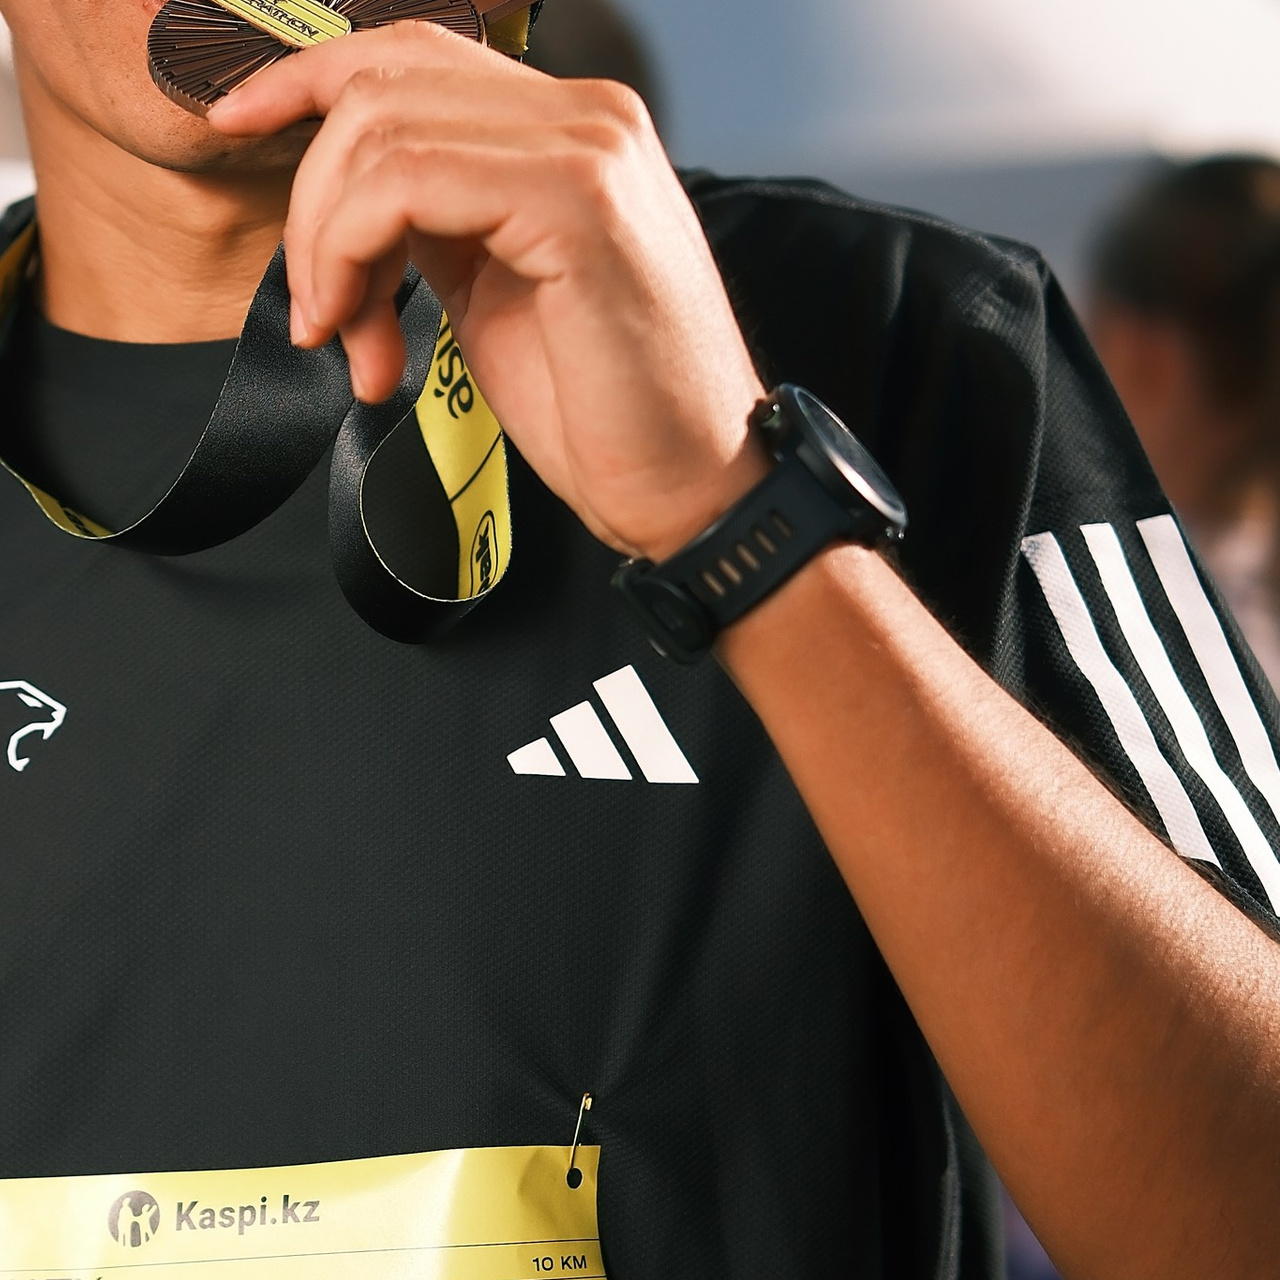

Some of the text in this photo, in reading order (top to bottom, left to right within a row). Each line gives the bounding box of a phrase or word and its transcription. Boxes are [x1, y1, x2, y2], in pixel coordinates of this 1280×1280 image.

[176, 1195, 320, 1235] Kaspi.kz
[532, 1255, 588, 1272] 10 KM
